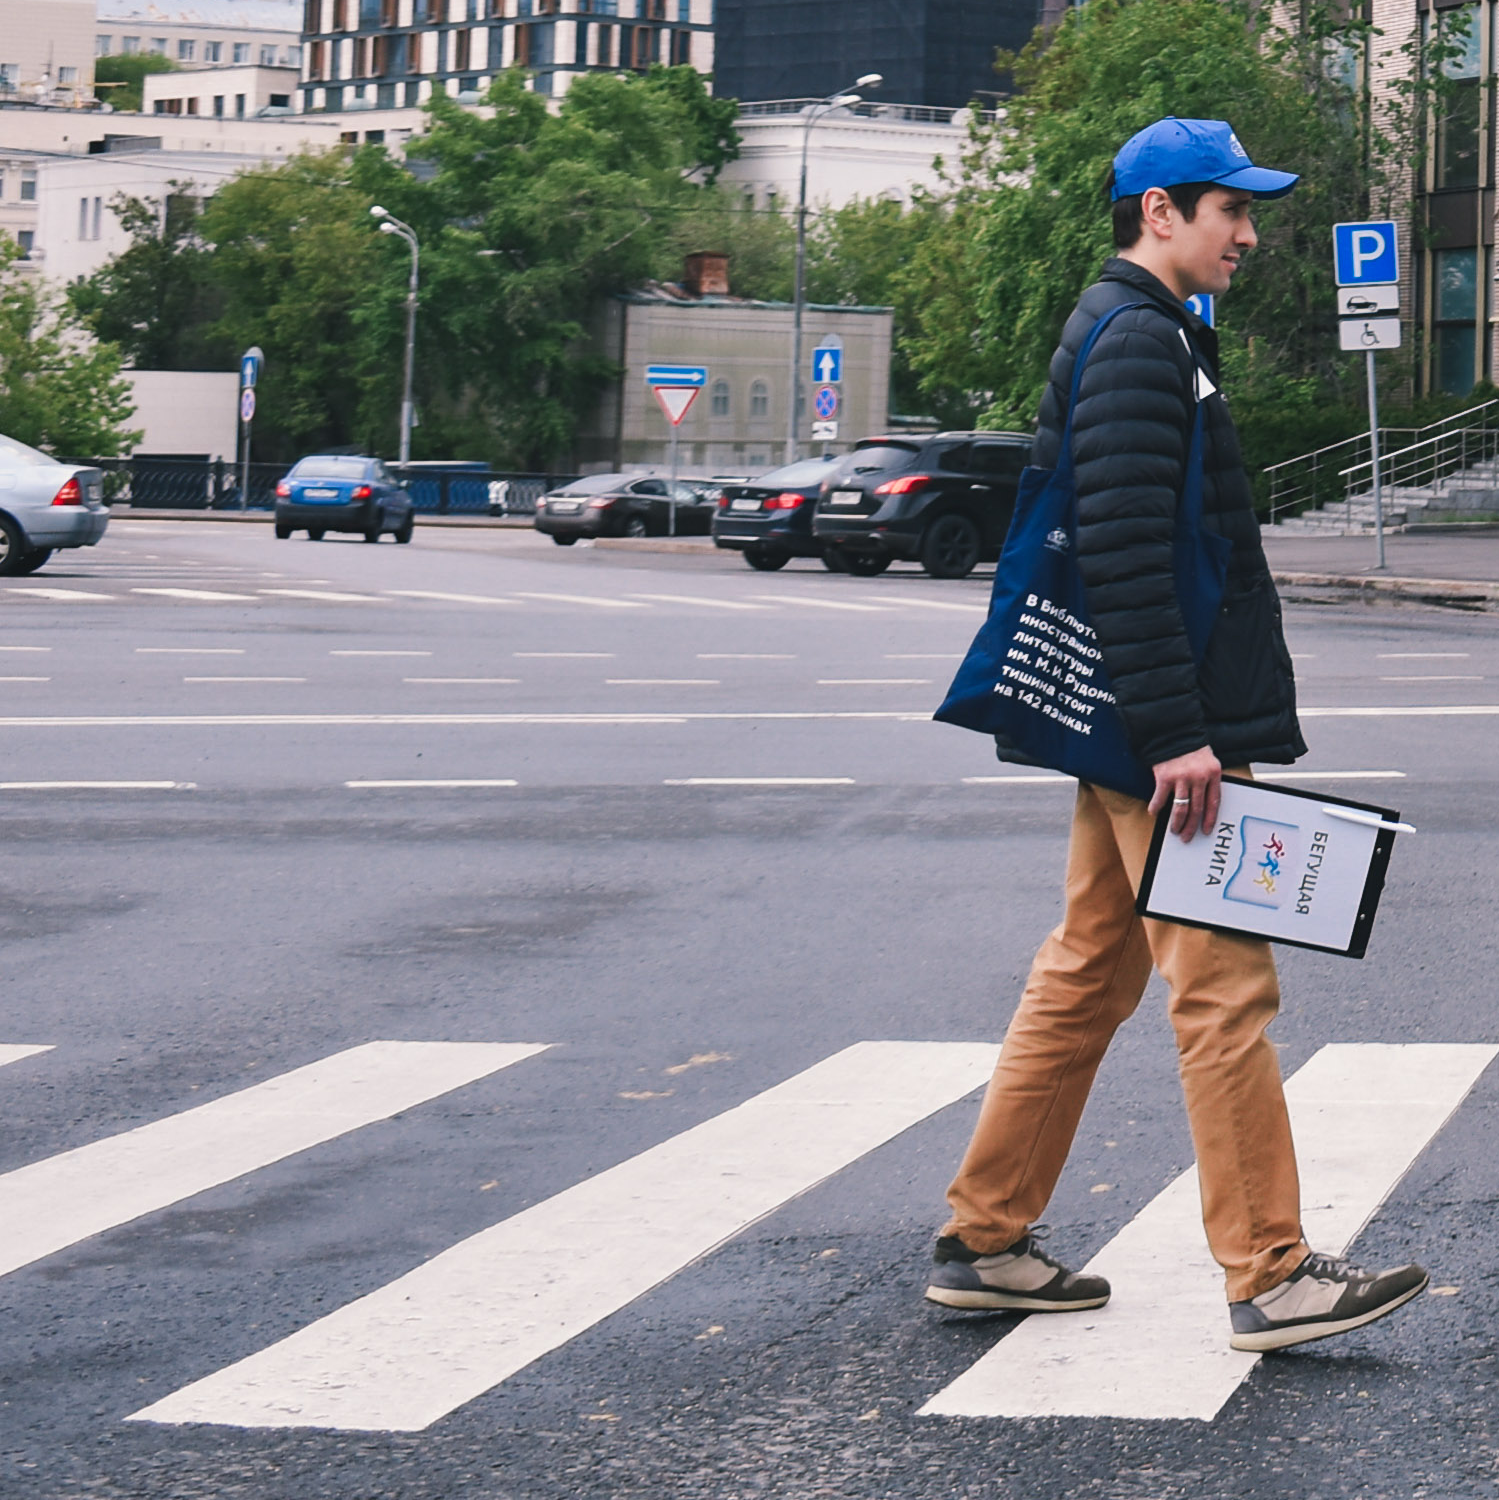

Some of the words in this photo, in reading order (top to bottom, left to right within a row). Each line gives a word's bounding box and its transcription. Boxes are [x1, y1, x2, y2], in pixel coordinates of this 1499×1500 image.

[1352, 230, 1385, 277] P
[1025, 593, 1038, 607] В
[1007, 647, 1032, 665] им.
[1064, 673, 1117, 705] Рудоми
[1012, 631, 1095, 677] литературы
[993, 682, 1014, 697] на
[1018, 689, 1042, 710] 142
[1042, 704, 1093, 736] языках
[1002, 665, 1055, 697] тишина
[1057, 692, 1096, 716] стоит
[1205, 822, 1235, 885] КНИГА
[1295, 831, 1328, 915] БЕГУЩАЯ
